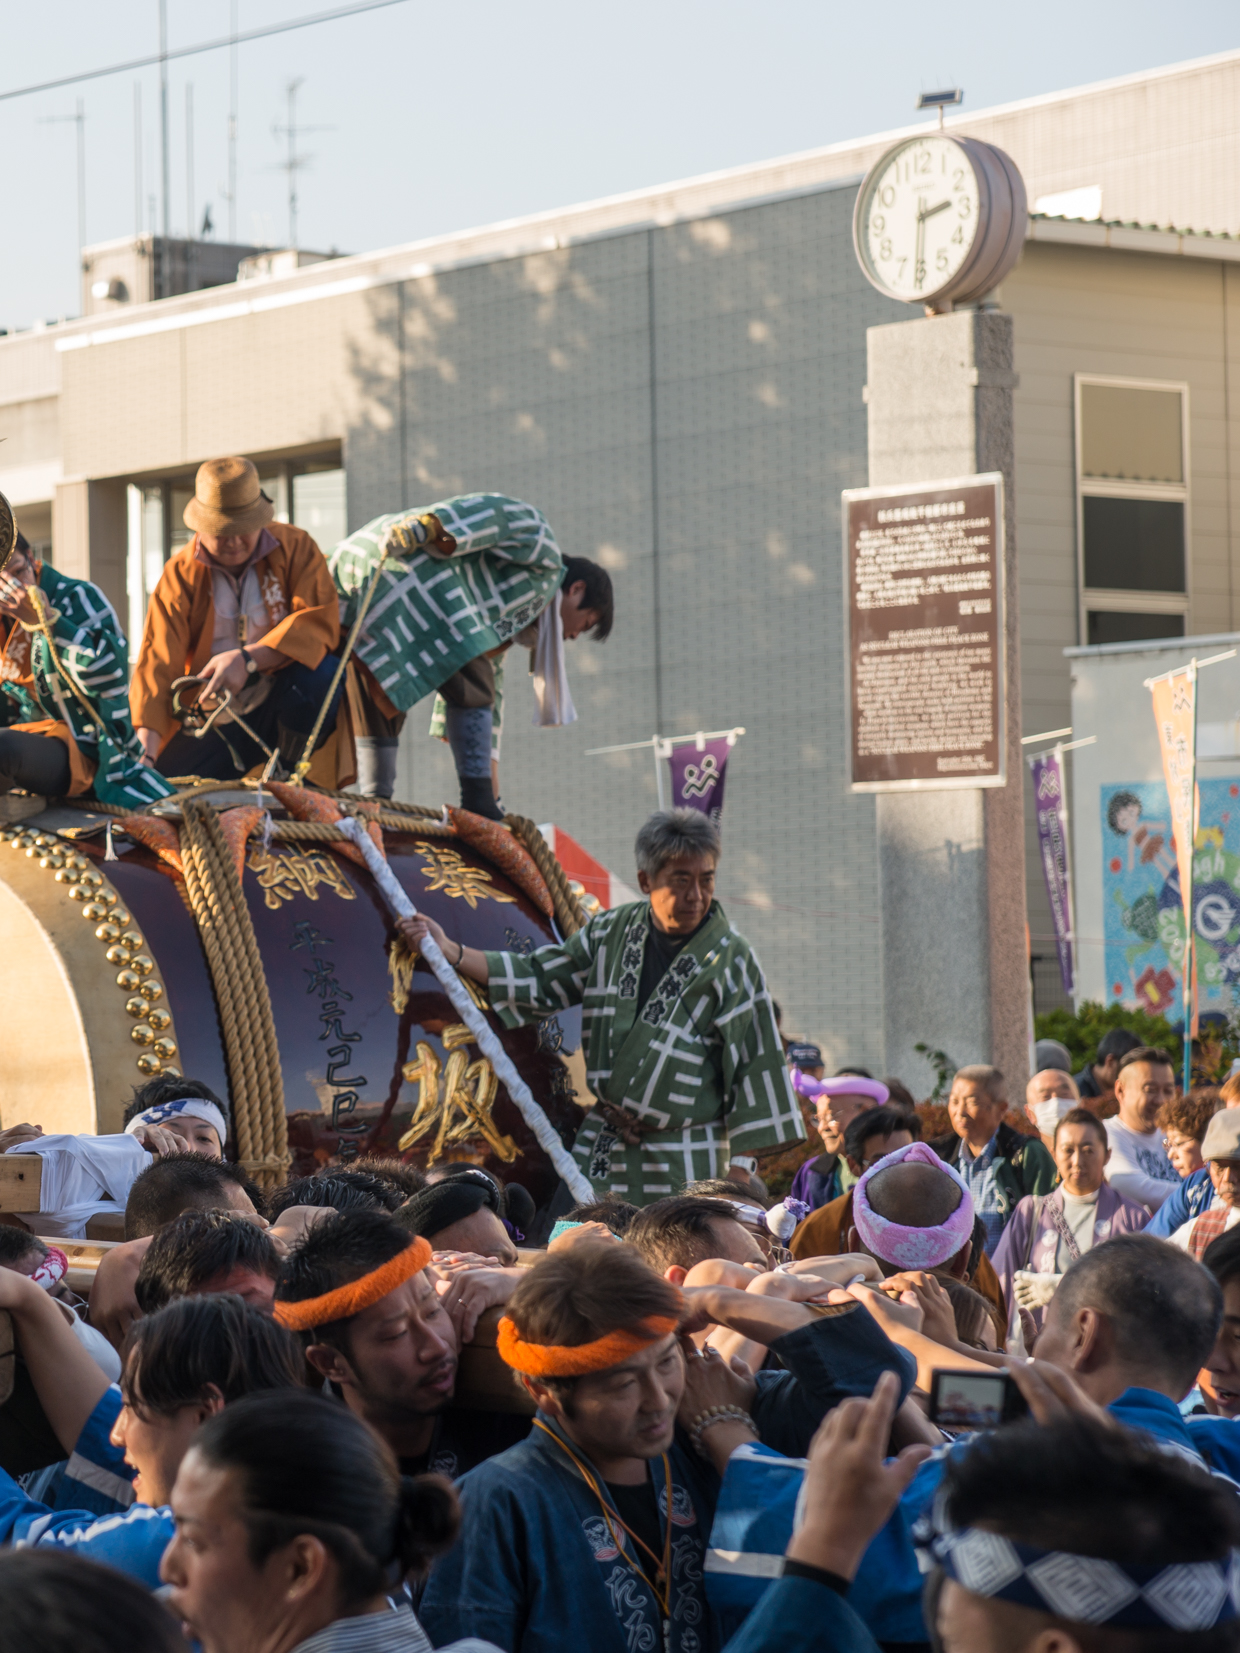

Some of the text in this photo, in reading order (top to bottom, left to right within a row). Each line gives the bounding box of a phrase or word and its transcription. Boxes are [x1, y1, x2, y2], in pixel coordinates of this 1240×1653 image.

[896, 161, 909, 184] 11
[914, 151, 932, 174] 12
[941, 152, 946, 174] 1
[953, 170, 965, 191] 2
[878, 184, 896, 208] 10
[959, 195, 971, 219] 3
[872, 214, 885, 237] 9
[951, 226, 964, 245] 4
[880, 238, 892, 261] 8
[935, 249, 948, 271] 5
[896, 256, 908, 278] 7
